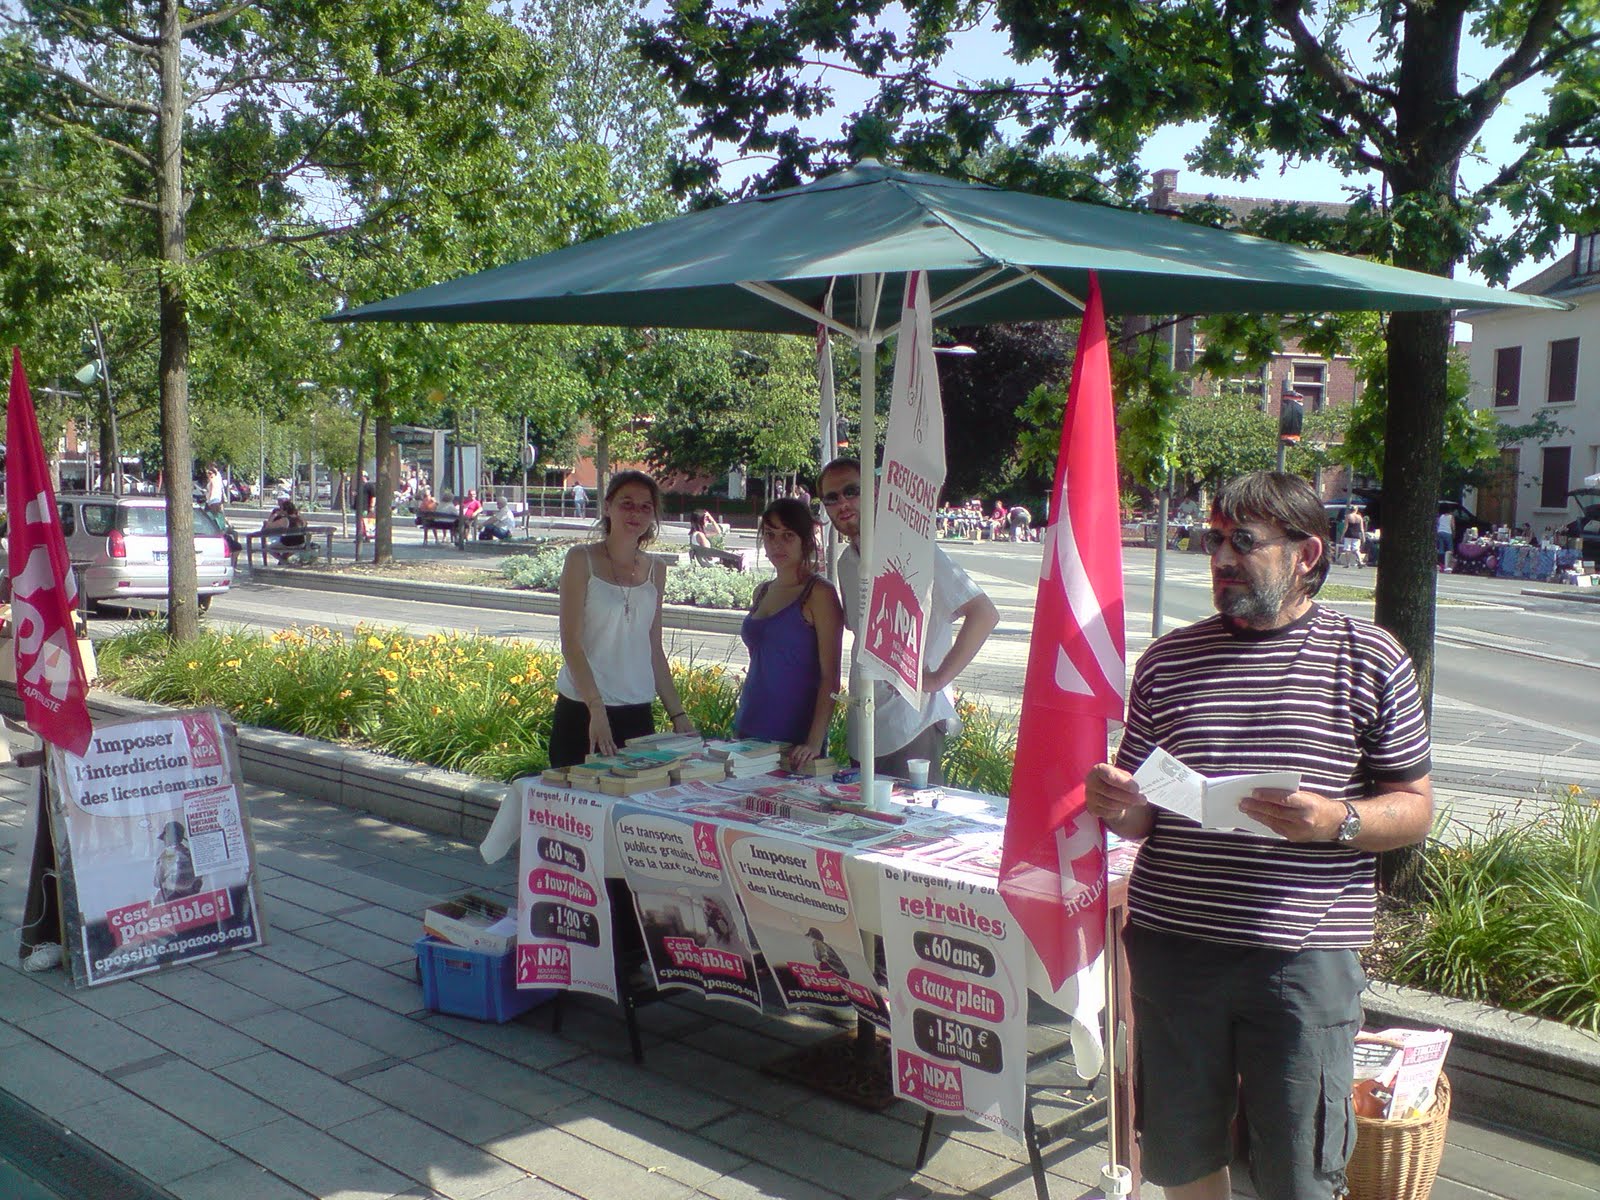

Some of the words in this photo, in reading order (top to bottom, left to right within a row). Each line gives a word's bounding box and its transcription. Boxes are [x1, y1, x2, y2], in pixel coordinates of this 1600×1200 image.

[886, 459, 937, 513] REFUSONS
[887, 491, 931, 540] L'ASTÉRITÉ
[94, 732, 174, 755] Imposer
[192, 744, 217, 759] NPA
[75, 754, 189, 782] l'interdiction
[80, 791, 109, 806] des
[112, 775, 218, 802] licenciements
[571, 796, 577, 805] y
[578, 797, 588, 805] en
[189, 809, 219, 819] MEETING
[529, 808, 592, 838] retraites
[191, 823, 221, 833] RÉGIONAL
[619, 822, 635, 836] Les
[636, 826, 683, 844] transports
[549, 841, 562, 861] 60
[624, 841, 657, 856] publics
[659, 846, 698, 864] gratuits,
[699, 849, 718, 863] NPA
[749, 844, 807, 870] Imposer
[627, 856, 645, 868] Pas
[646, 859, 657, 870] la
[659, 861, 681, 872] taxe
[683, 865, 719, 882] carbone
[739, 861, 821, 891] l'interdiction
[885, 868, 899, 880] De
[903, 870, 952, 890] l'argent,
[956, 880, 965, 890] il
[969, 884, 977, 894] y
[980, 886, 995, 895] en
[545, 873, 569, 894] taux
[822, 877, 843, 893] NPA
[747, 881, 767, 894] des
[768, 886, 847, 916] licenciements
[111, 907, 149, 926] c'est
[119, 901, 214, 945] possible
[557, 906, 580, 930] 100
[583, 913, 591, 926] €
[899, 896, 1004, 937] retraites
[94, 926, 252, 971] cpossible.npa2009.org
[537, 947, 568, 966] NPA
[667, 940, 693, 951] c'est
[924, 944, 930, 956] à
[932, 937, 951, 961] 60
[952, 947, 985, 974] ans,
[674, 950, 734, 970] posible
[792, 964, 817, 976] c'est
[800, 973, 864, 998] possble
[914, 982, 920, 992] à
[922, 976, 954, 1004] taux
[956, 983, 995, 1015] plein
[929, 1025, 934, 1037] à
[936, 1018, 973, 1049] 1500
[977, 1031, 988, 1048] €
[923, 1063, 960, 1092] NPA
